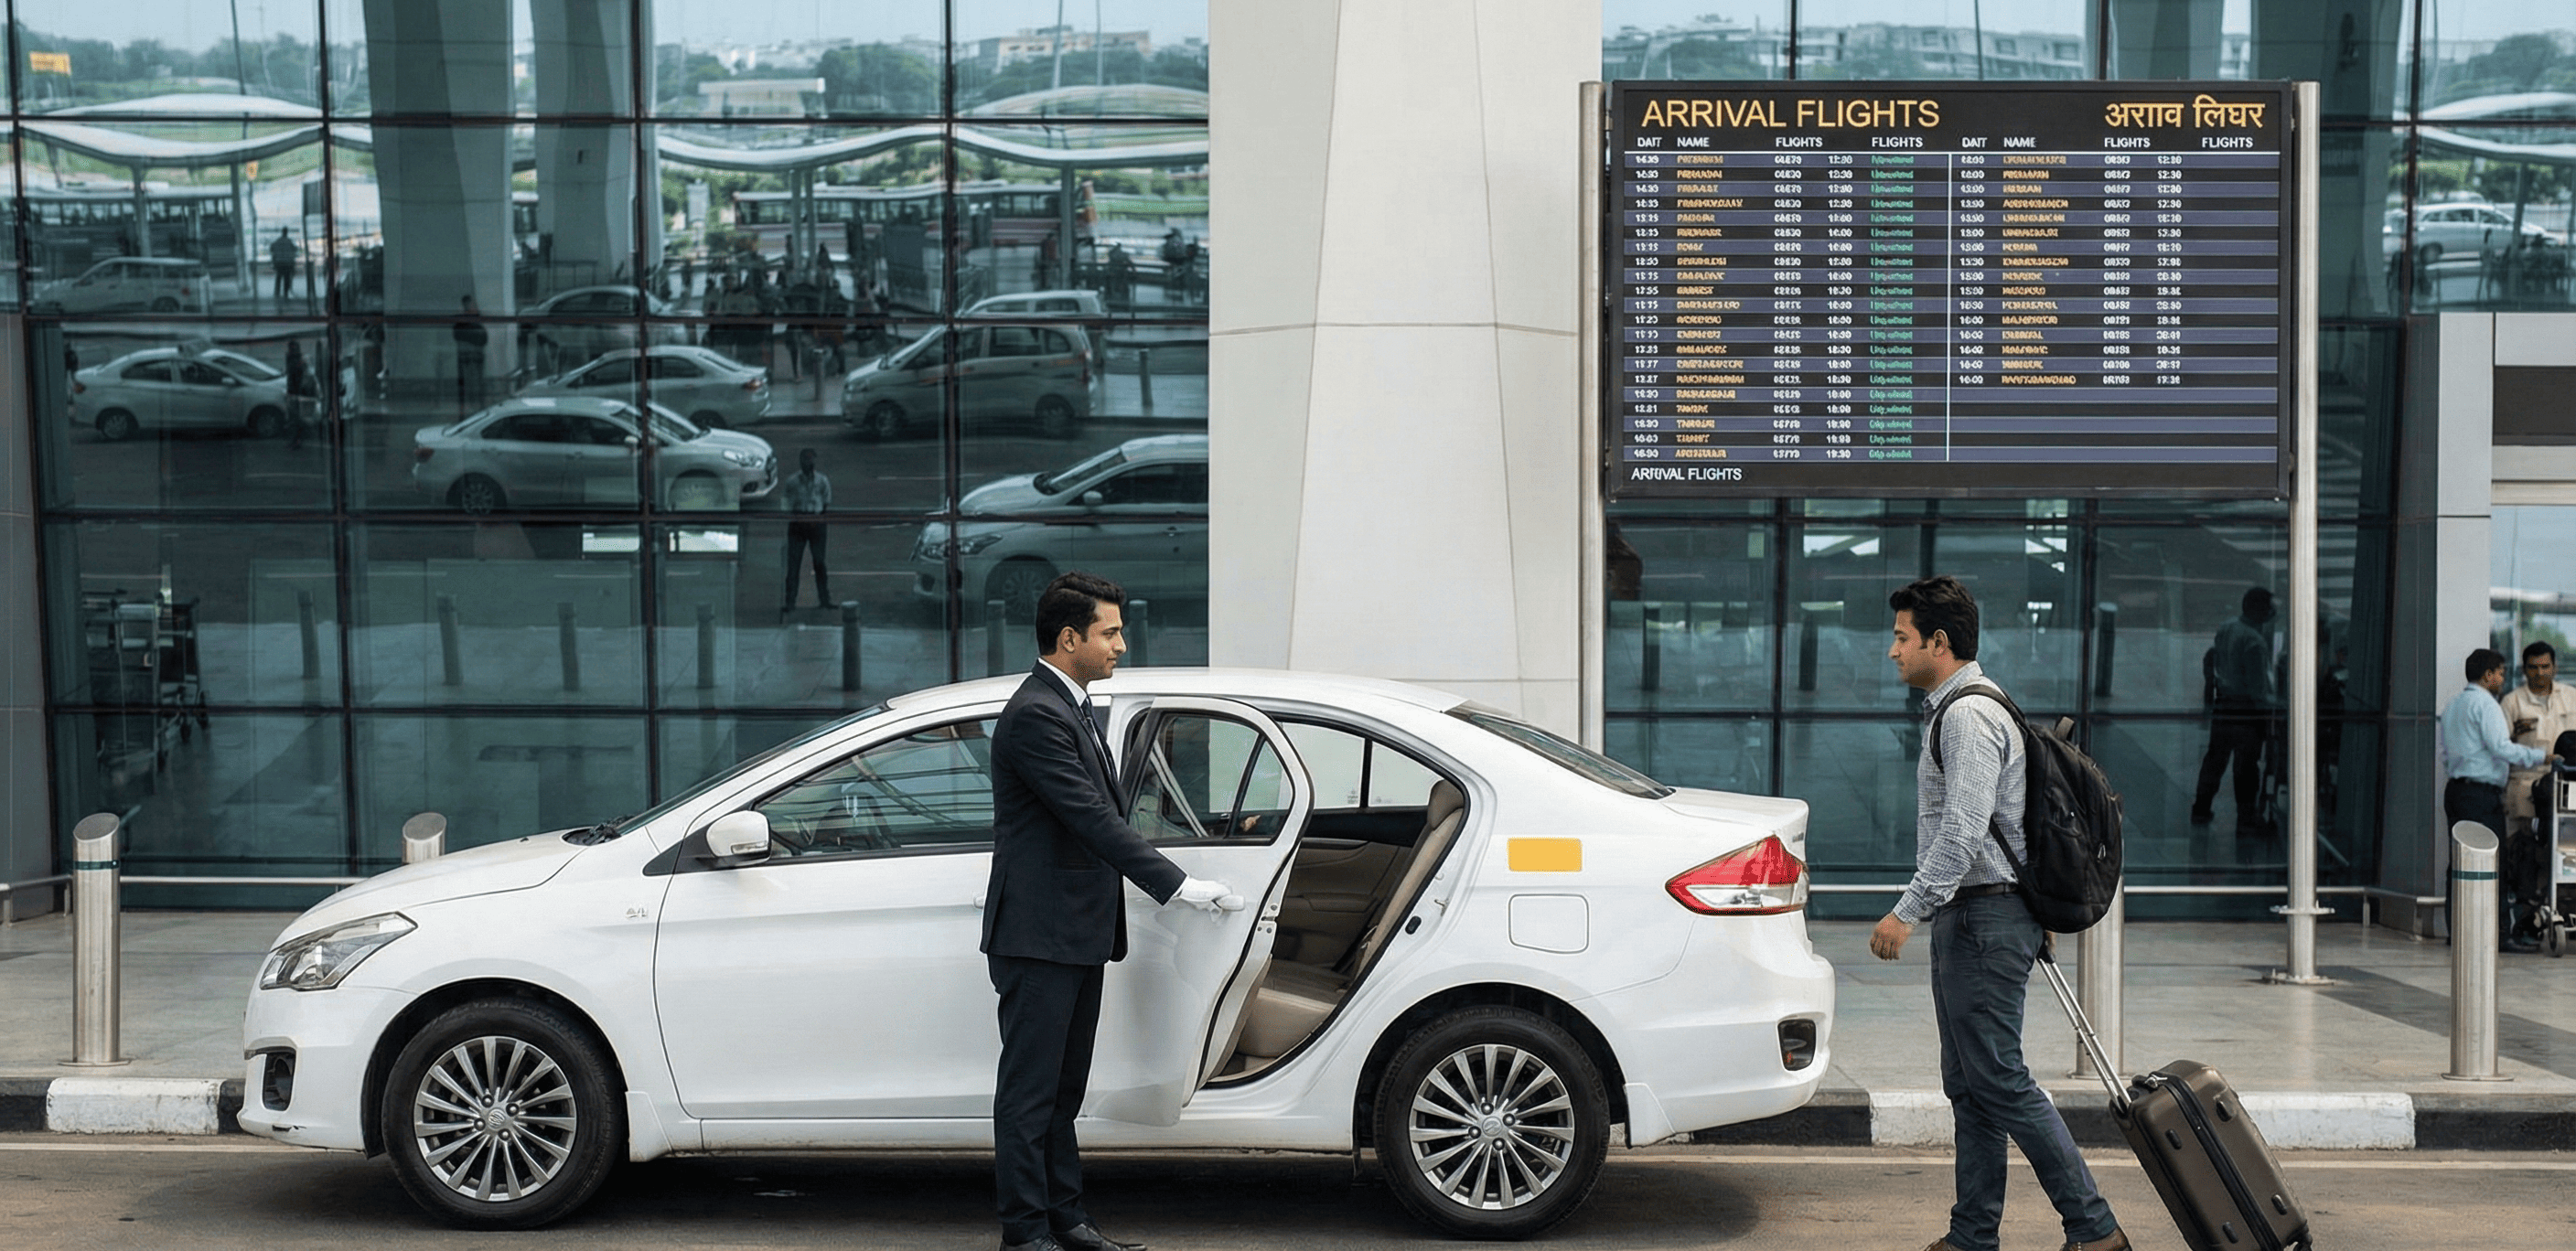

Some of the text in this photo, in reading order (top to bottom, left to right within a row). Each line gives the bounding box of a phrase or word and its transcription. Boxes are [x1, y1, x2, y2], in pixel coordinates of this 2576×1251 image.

[1641, 99, 1940, 128] ARRIVAL FLIGHTS
[1677, 136, 1711, 148] NAME
[1775, 136, 1823, 148] FLIGHTS
[1871, 136, 1924, 148] FLIGHTS
[2003, 136, 2036, 148] NAME
[2103, 136, 2152, 148] FLIGHTS
[2201, 136, 2254, 148] FLIGHTS
[1688, 466, 1743, 481] FLIGHTS
